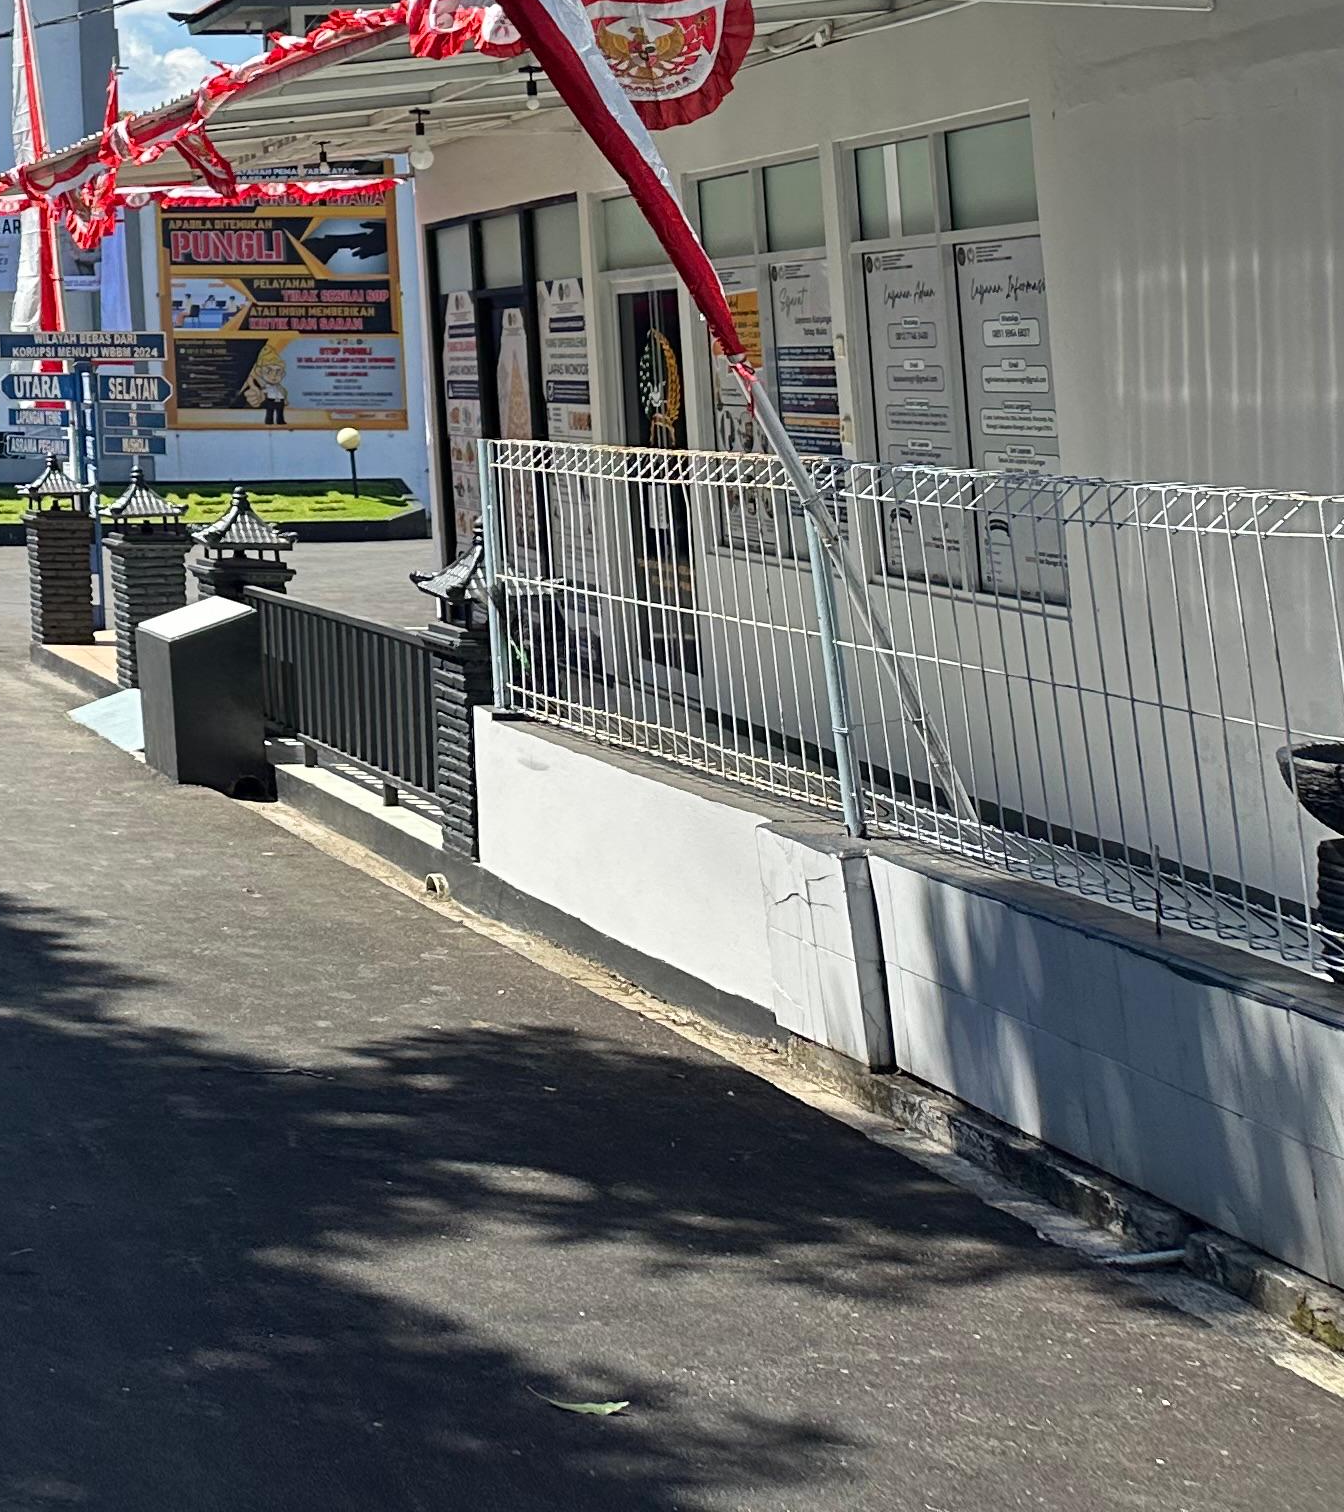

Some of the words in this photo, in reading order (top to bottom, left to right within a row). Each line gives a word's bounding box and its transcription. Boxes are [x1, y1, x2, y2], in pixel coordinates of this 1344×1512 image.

[169, 220, 212, 230] APABILA
[215, 220, 272, 230] DITEMUKAN
[171, 230, 285, 262] PUNGLI
[254, 279, 315, 288] PELAYANAN
[250, 307, 276, 316] ATAU
[308, 307, 375, 317] MEMBERIKAN
[33, 334, 76, 344] WILAYAH
[79, 334, 111, 344] BEBAS
[114, 334, 137, 344] DARI
[12, 347, 55, 357] KORUPSI
[58, 347, 98, 357] MENUJU
[101, 347, 132, 357] WBBM
[134, 347, 158, 357] 2024
[14, 375, 61, 399] UTARA
[108, 377, 158, 400] SELATAN
